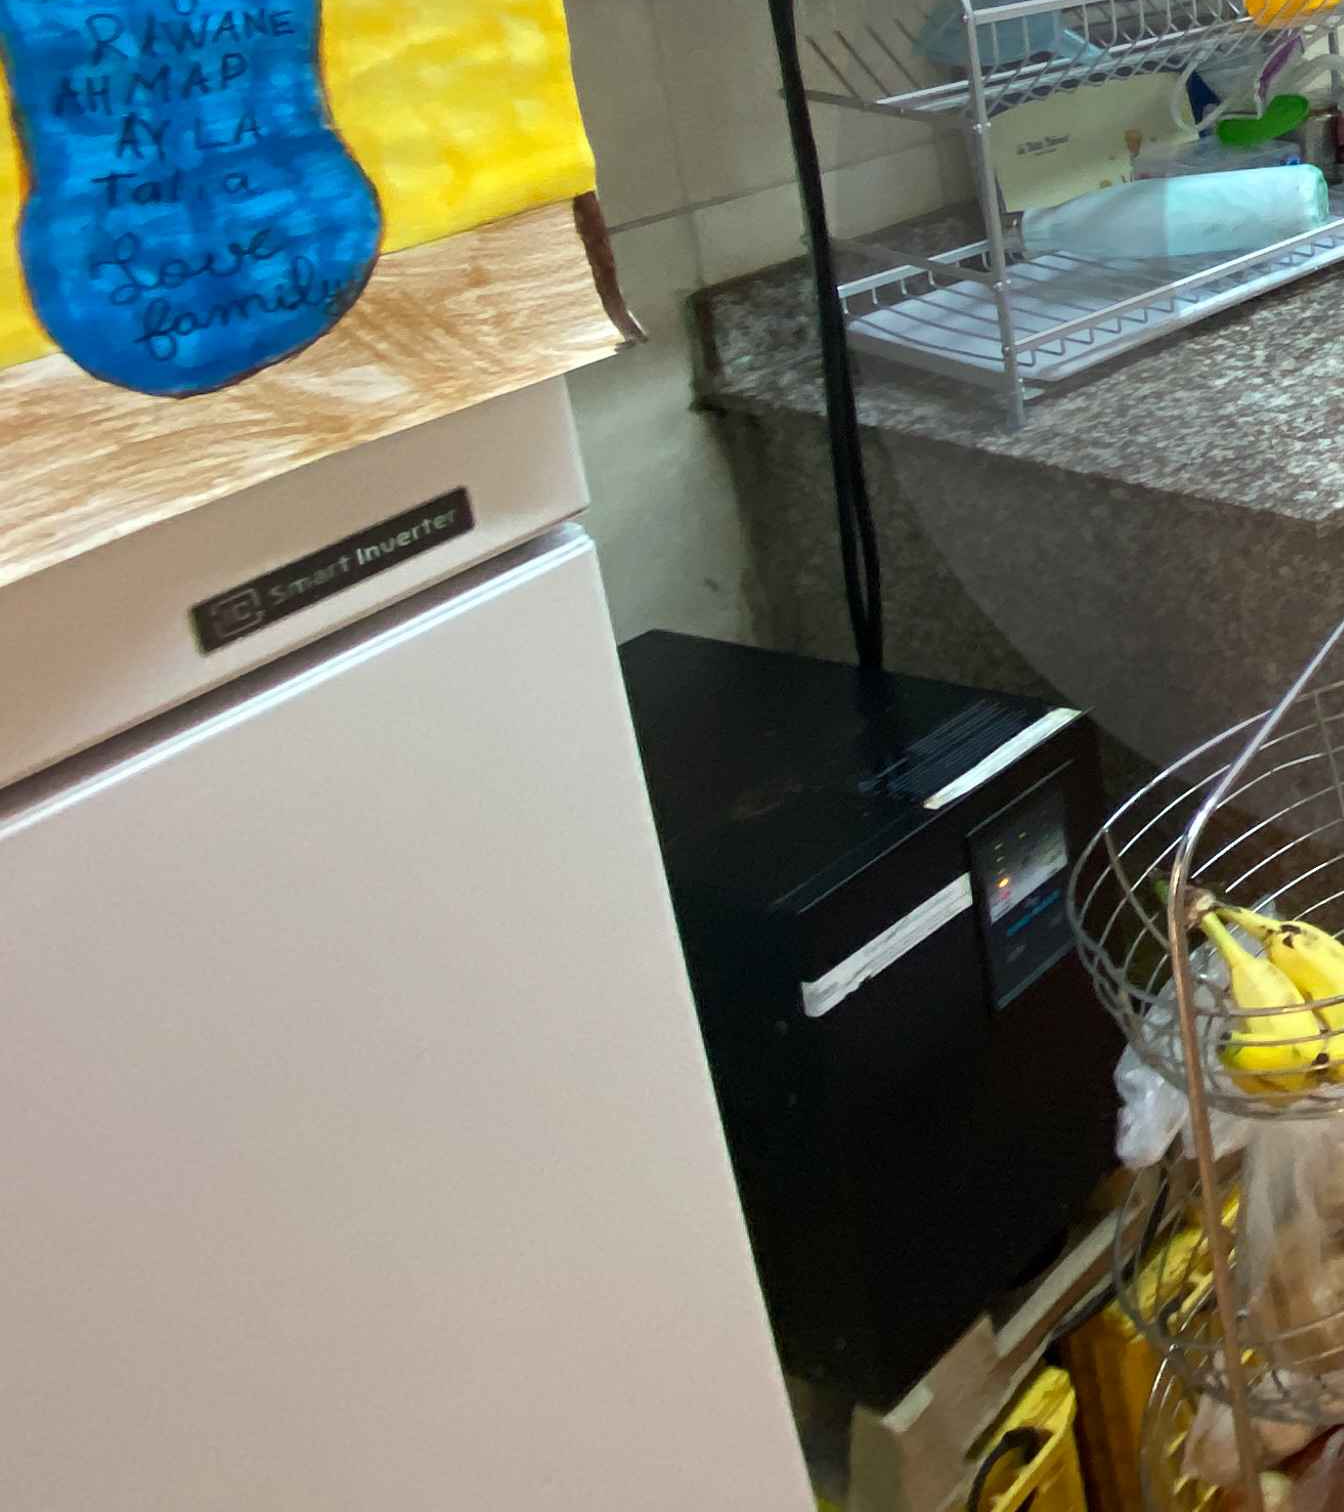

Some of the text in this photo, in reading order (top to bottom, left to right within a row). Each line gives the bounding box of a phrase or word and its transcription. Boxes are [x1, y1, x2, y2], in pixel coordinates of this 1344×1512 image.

[85, 10, 296, 64] RAWANE
[268, 508, 458, 605] Smart Inverter
